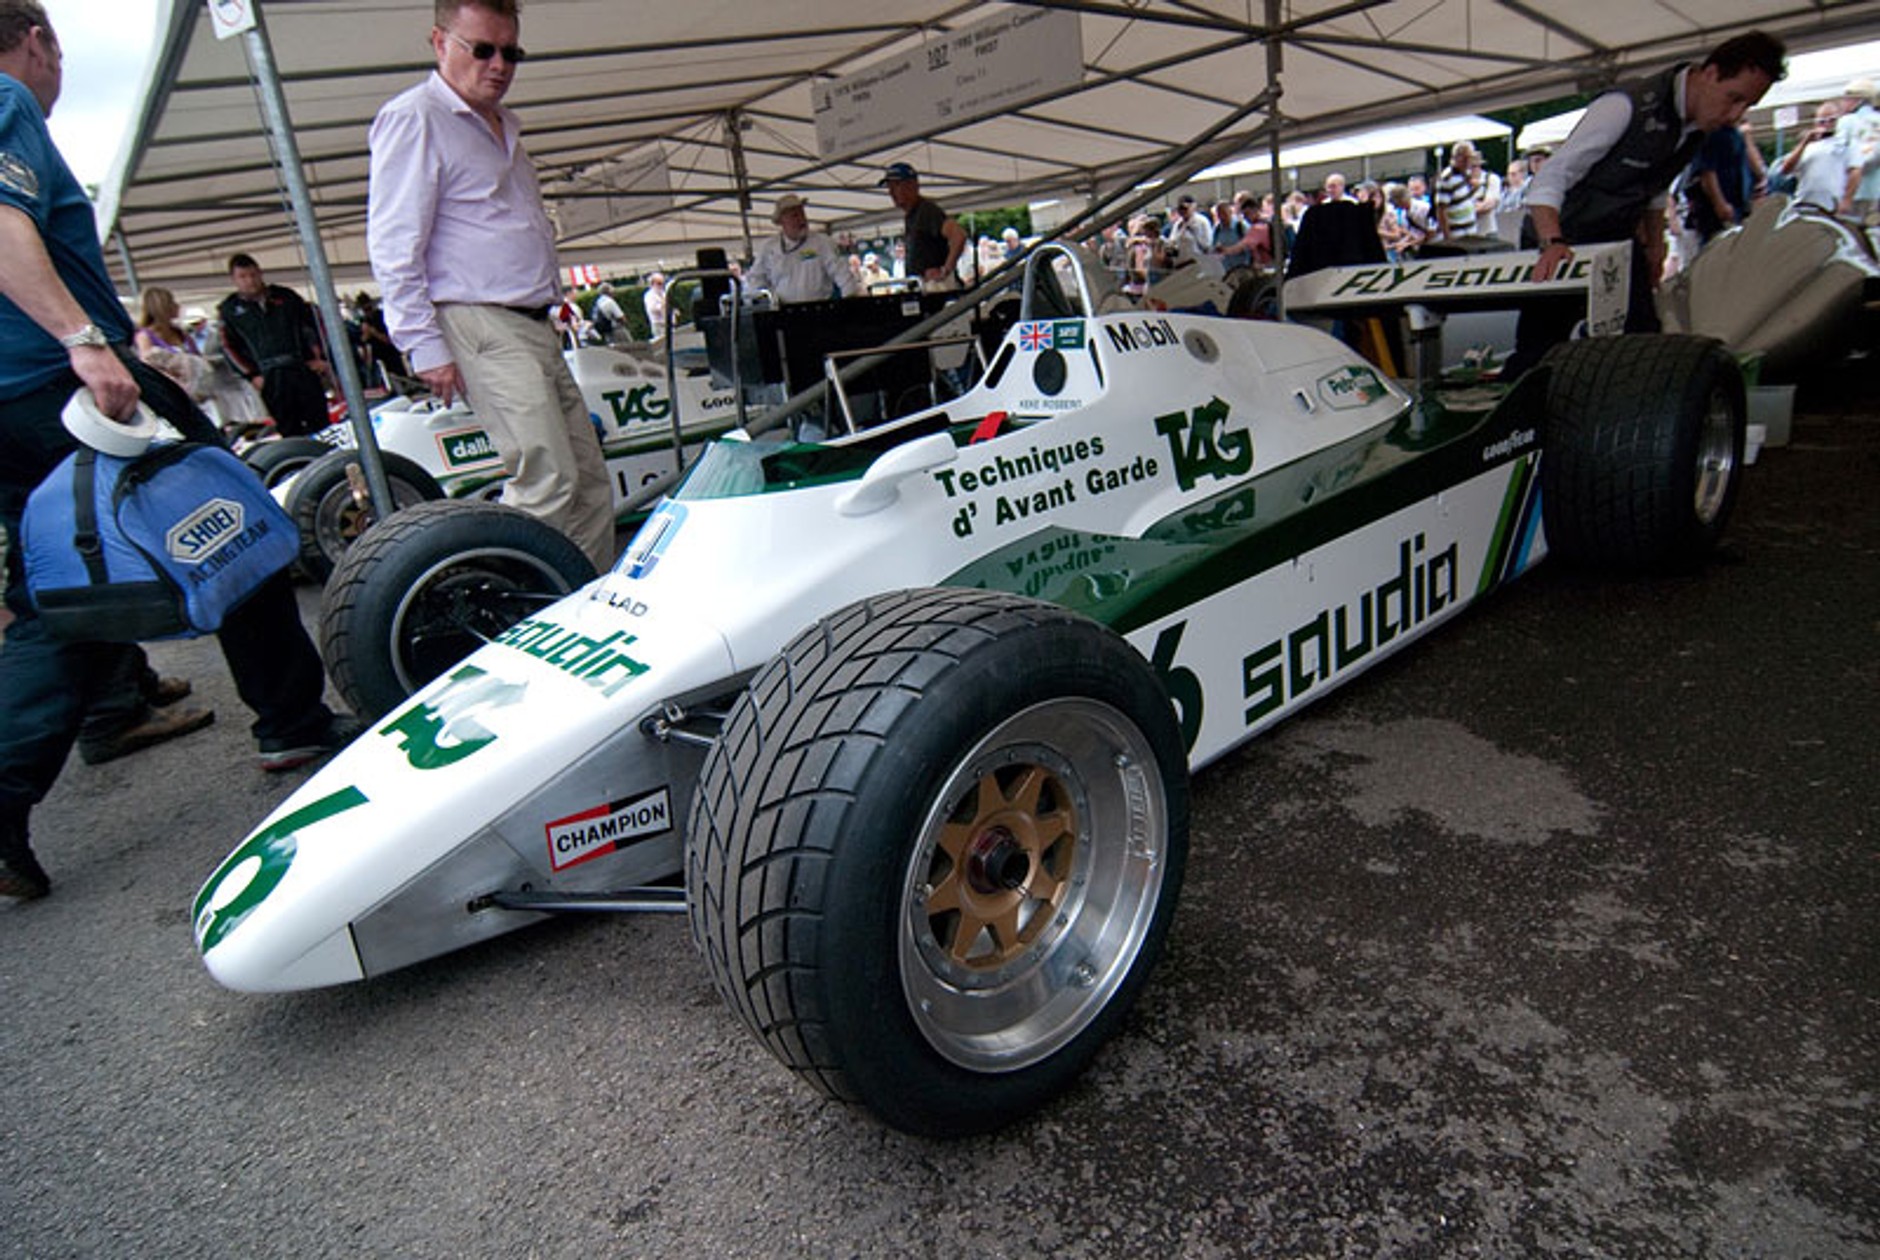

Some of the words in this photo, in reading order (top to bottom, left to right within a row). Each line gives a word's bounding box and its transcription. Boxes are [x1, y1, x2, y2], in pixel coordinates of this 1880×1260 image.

[1332, 264, 1430, 297] FLY
[1105, 319, 1180, 353] Mobil
[602, 384, 671, 427] TAG
[934, 436, 1105, 498] Techniques
[1154, 395, 1254, 492] TAG
[996, 478, 1076, 526] Avant
[1085, 456, 1158, 495] Garde
[178, 508, 236, 554] SHOEI
[188, 545, 239, 587] ACING
[232, 518, 271, 553] TEAM
[493, 620, 651, 698] saudia
[1242, 532, 1459, 726] saudia
[1150, 619, 1204, 757] 6
[556, 802, 665, 852] CHAMPION
[193, 784, 370, 955] 6
